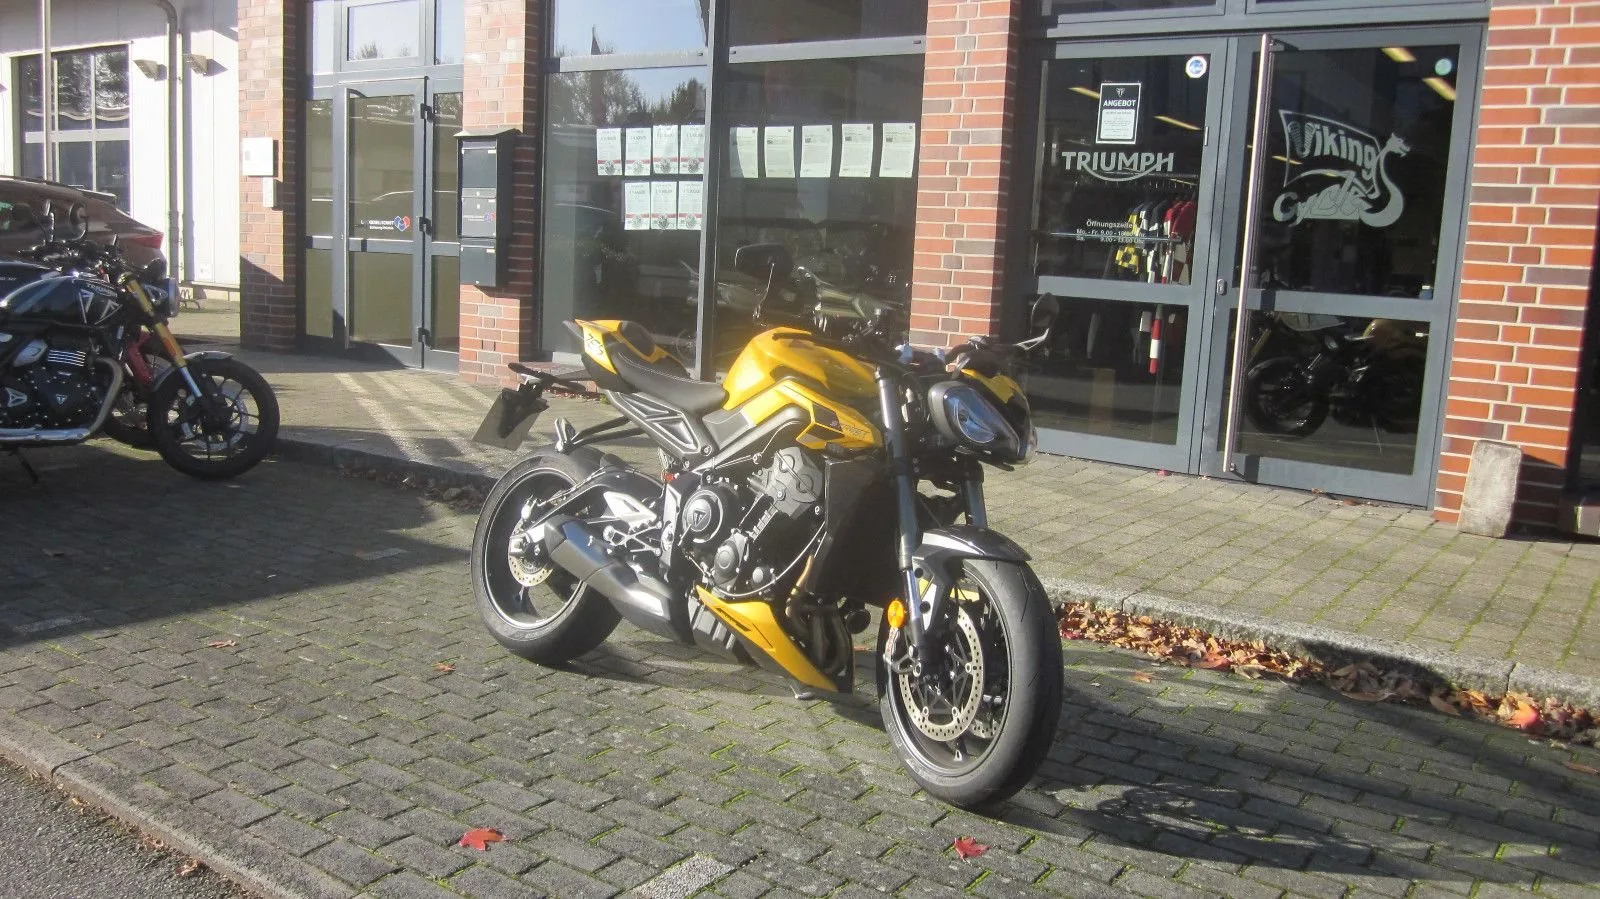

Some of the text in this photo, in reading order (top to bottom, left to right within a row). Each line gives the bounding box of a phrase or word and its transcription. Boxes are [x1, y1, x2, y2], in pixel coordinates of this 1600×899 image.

[1103, 99, 1137, 107] ANGEBOT
[1061, 151, 1175, 182] TRIUMPH
[1287, 121, 1378, 181] Viking
